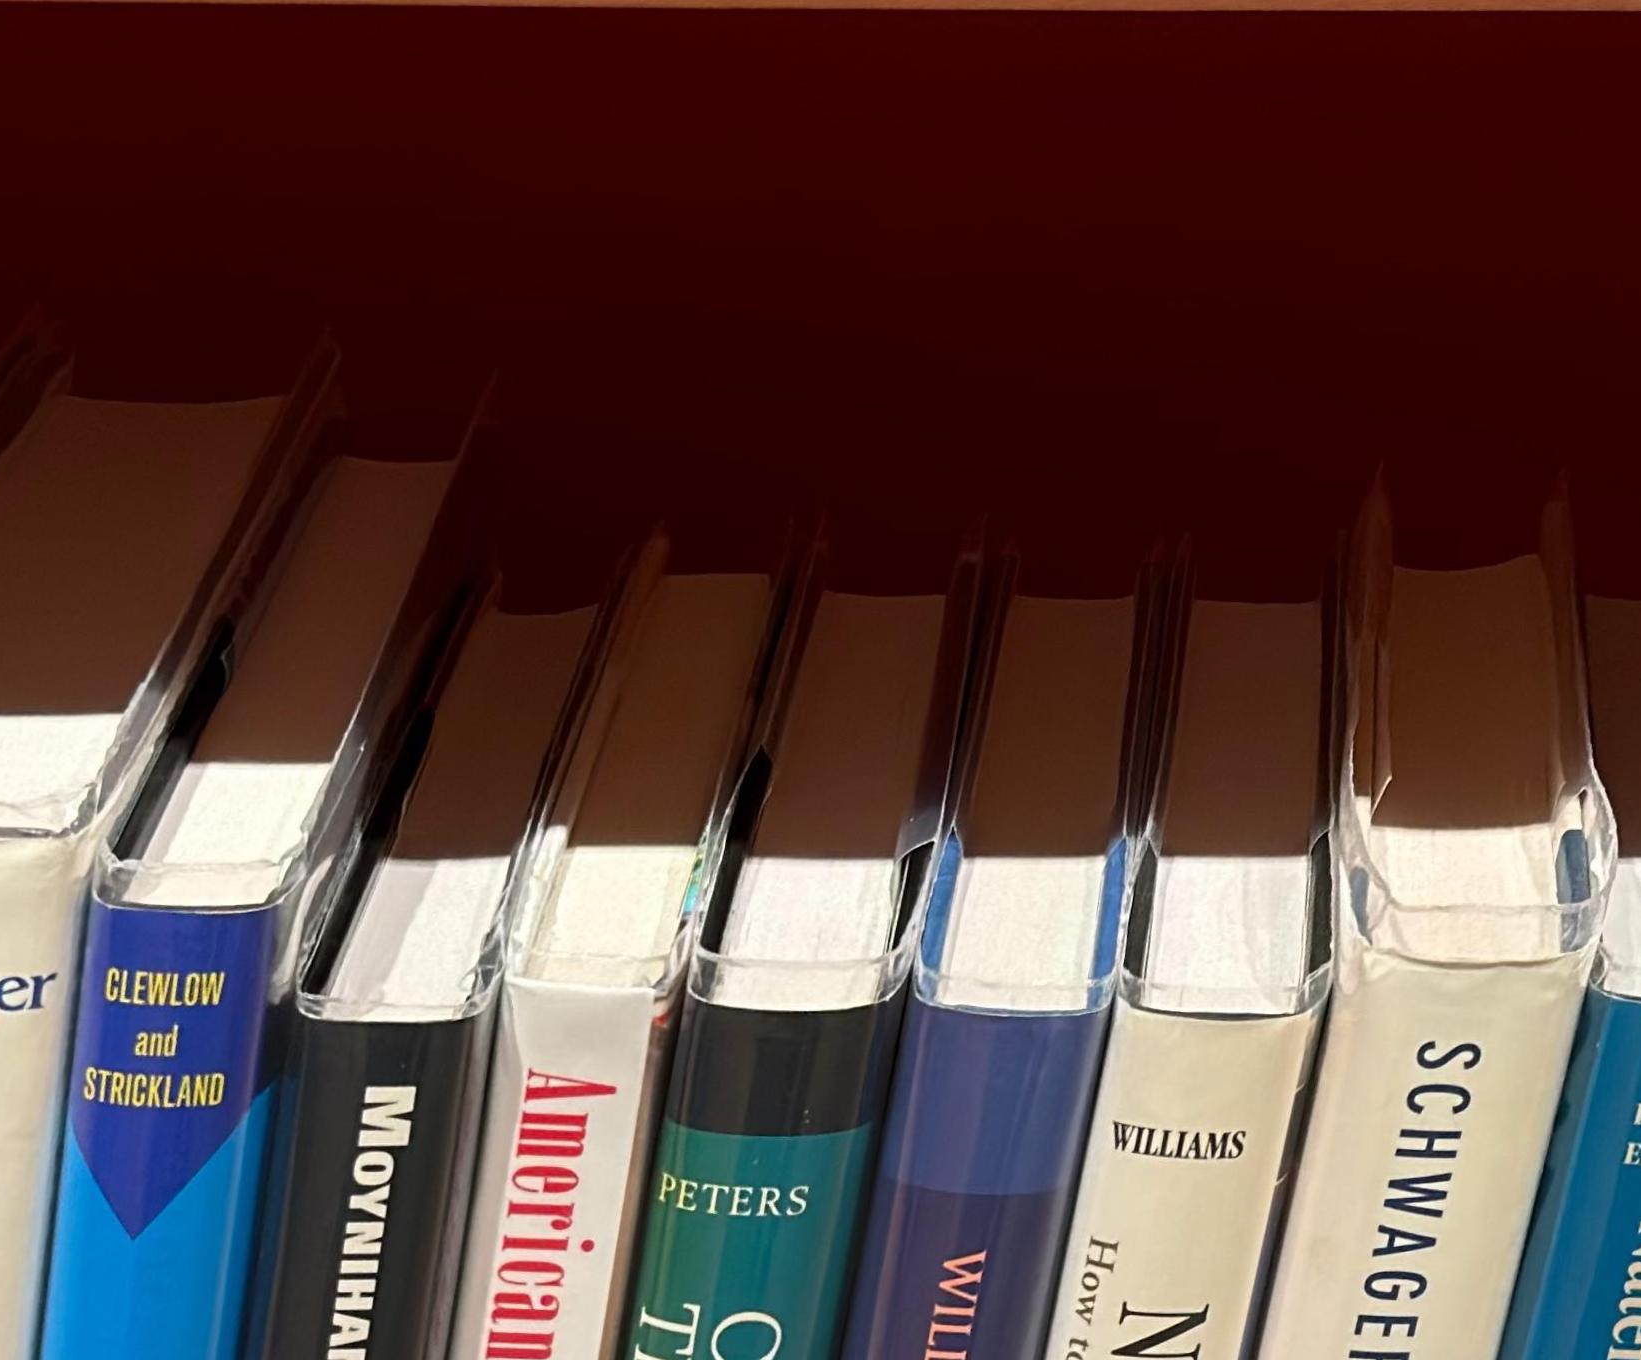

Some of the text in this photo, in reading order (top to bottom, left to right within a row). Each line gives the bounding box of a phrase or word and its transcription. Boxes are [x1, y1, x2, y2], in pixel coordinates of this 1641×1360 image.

[105, 969, 225, 1007] CLEWLOW
[135, 1026, 178, 1057] and
[84, 1068, 225, 1108] STRICKLAND
[1112, 1121, 1247, 1161] WILLIAMS
[485, 1068, 617, 1360] American
[660, 1173, 810, 1217] PETERS
[1080, 1237, 1119, 1326] How
